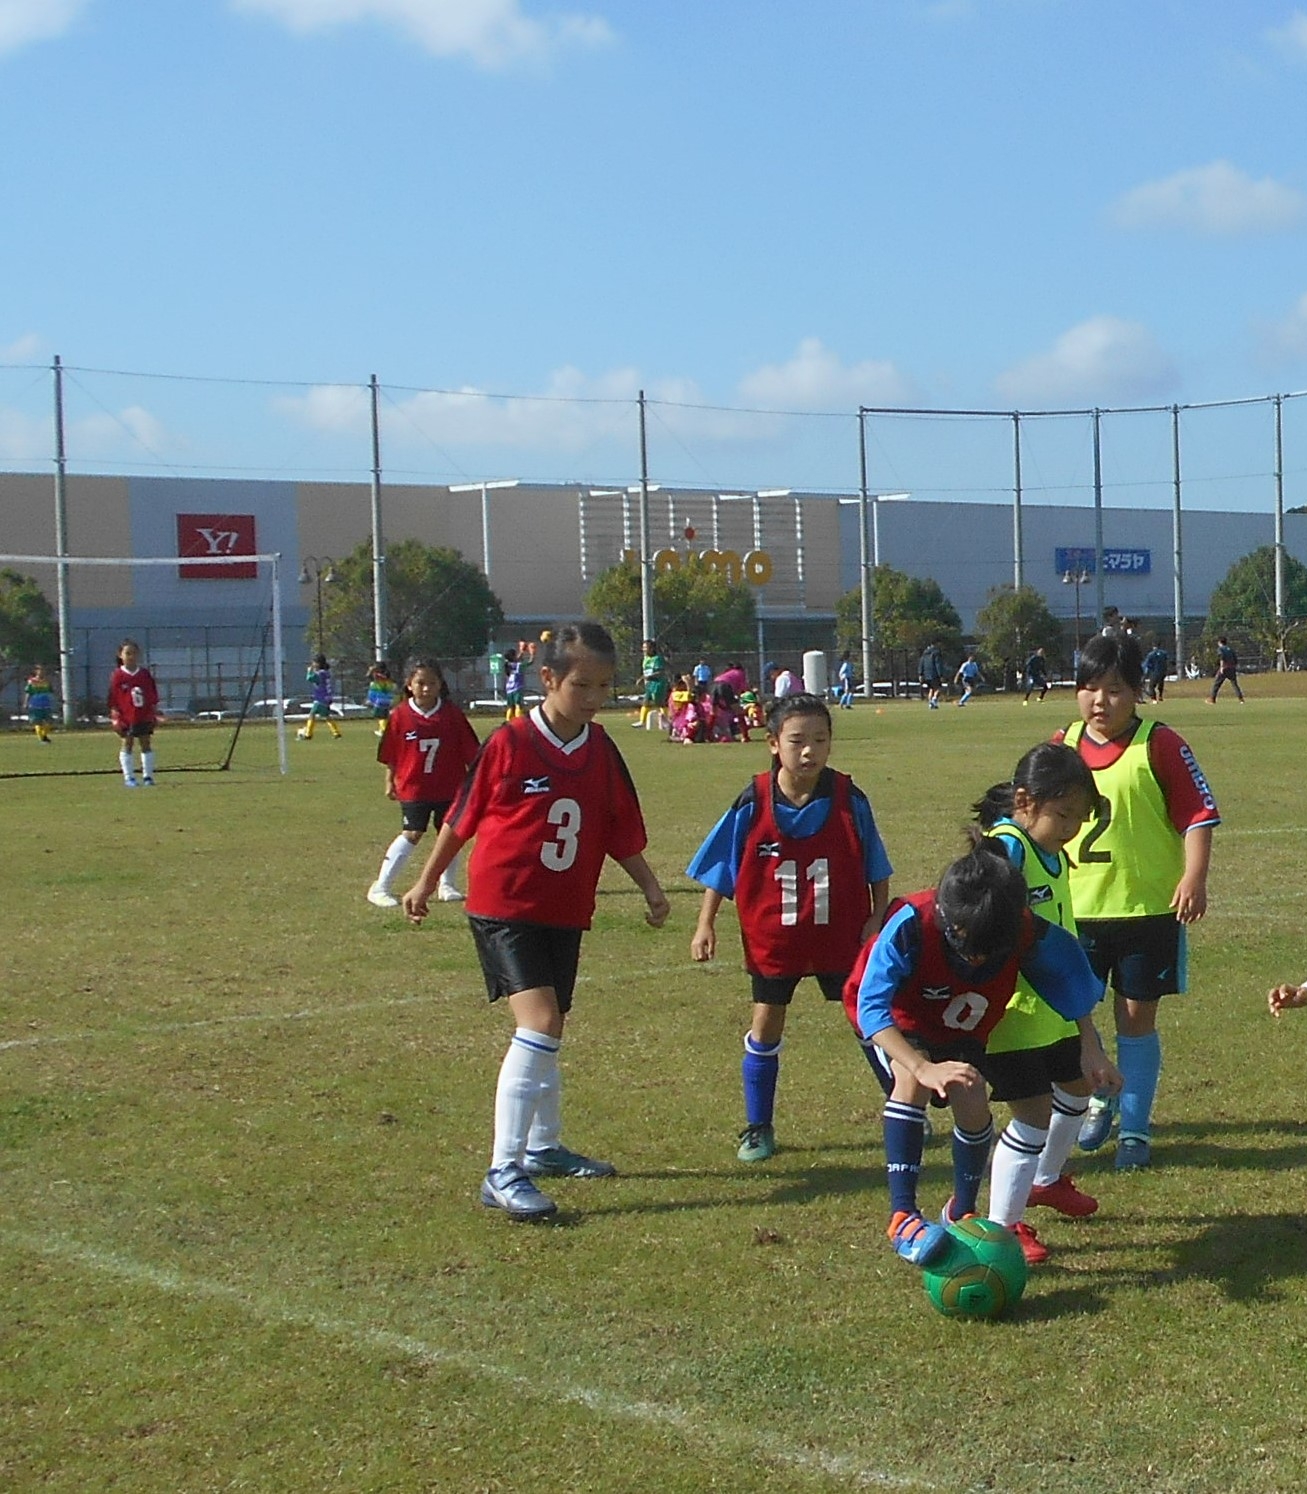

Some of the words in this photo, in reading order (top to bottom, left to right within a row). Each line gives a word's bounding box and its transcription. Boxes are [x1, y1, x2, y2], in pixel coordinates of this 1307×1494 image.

[195, 528, 239, 554] Y!
[130, 686, 144, 707] 6
[419, 738, 440, 774] 7
[1179, 745, 1216, 810] umbro
[540, 798, 582, 871] 3
[1078, 794, 1112, 863] 2
[774, 858, 830, 925] 11
